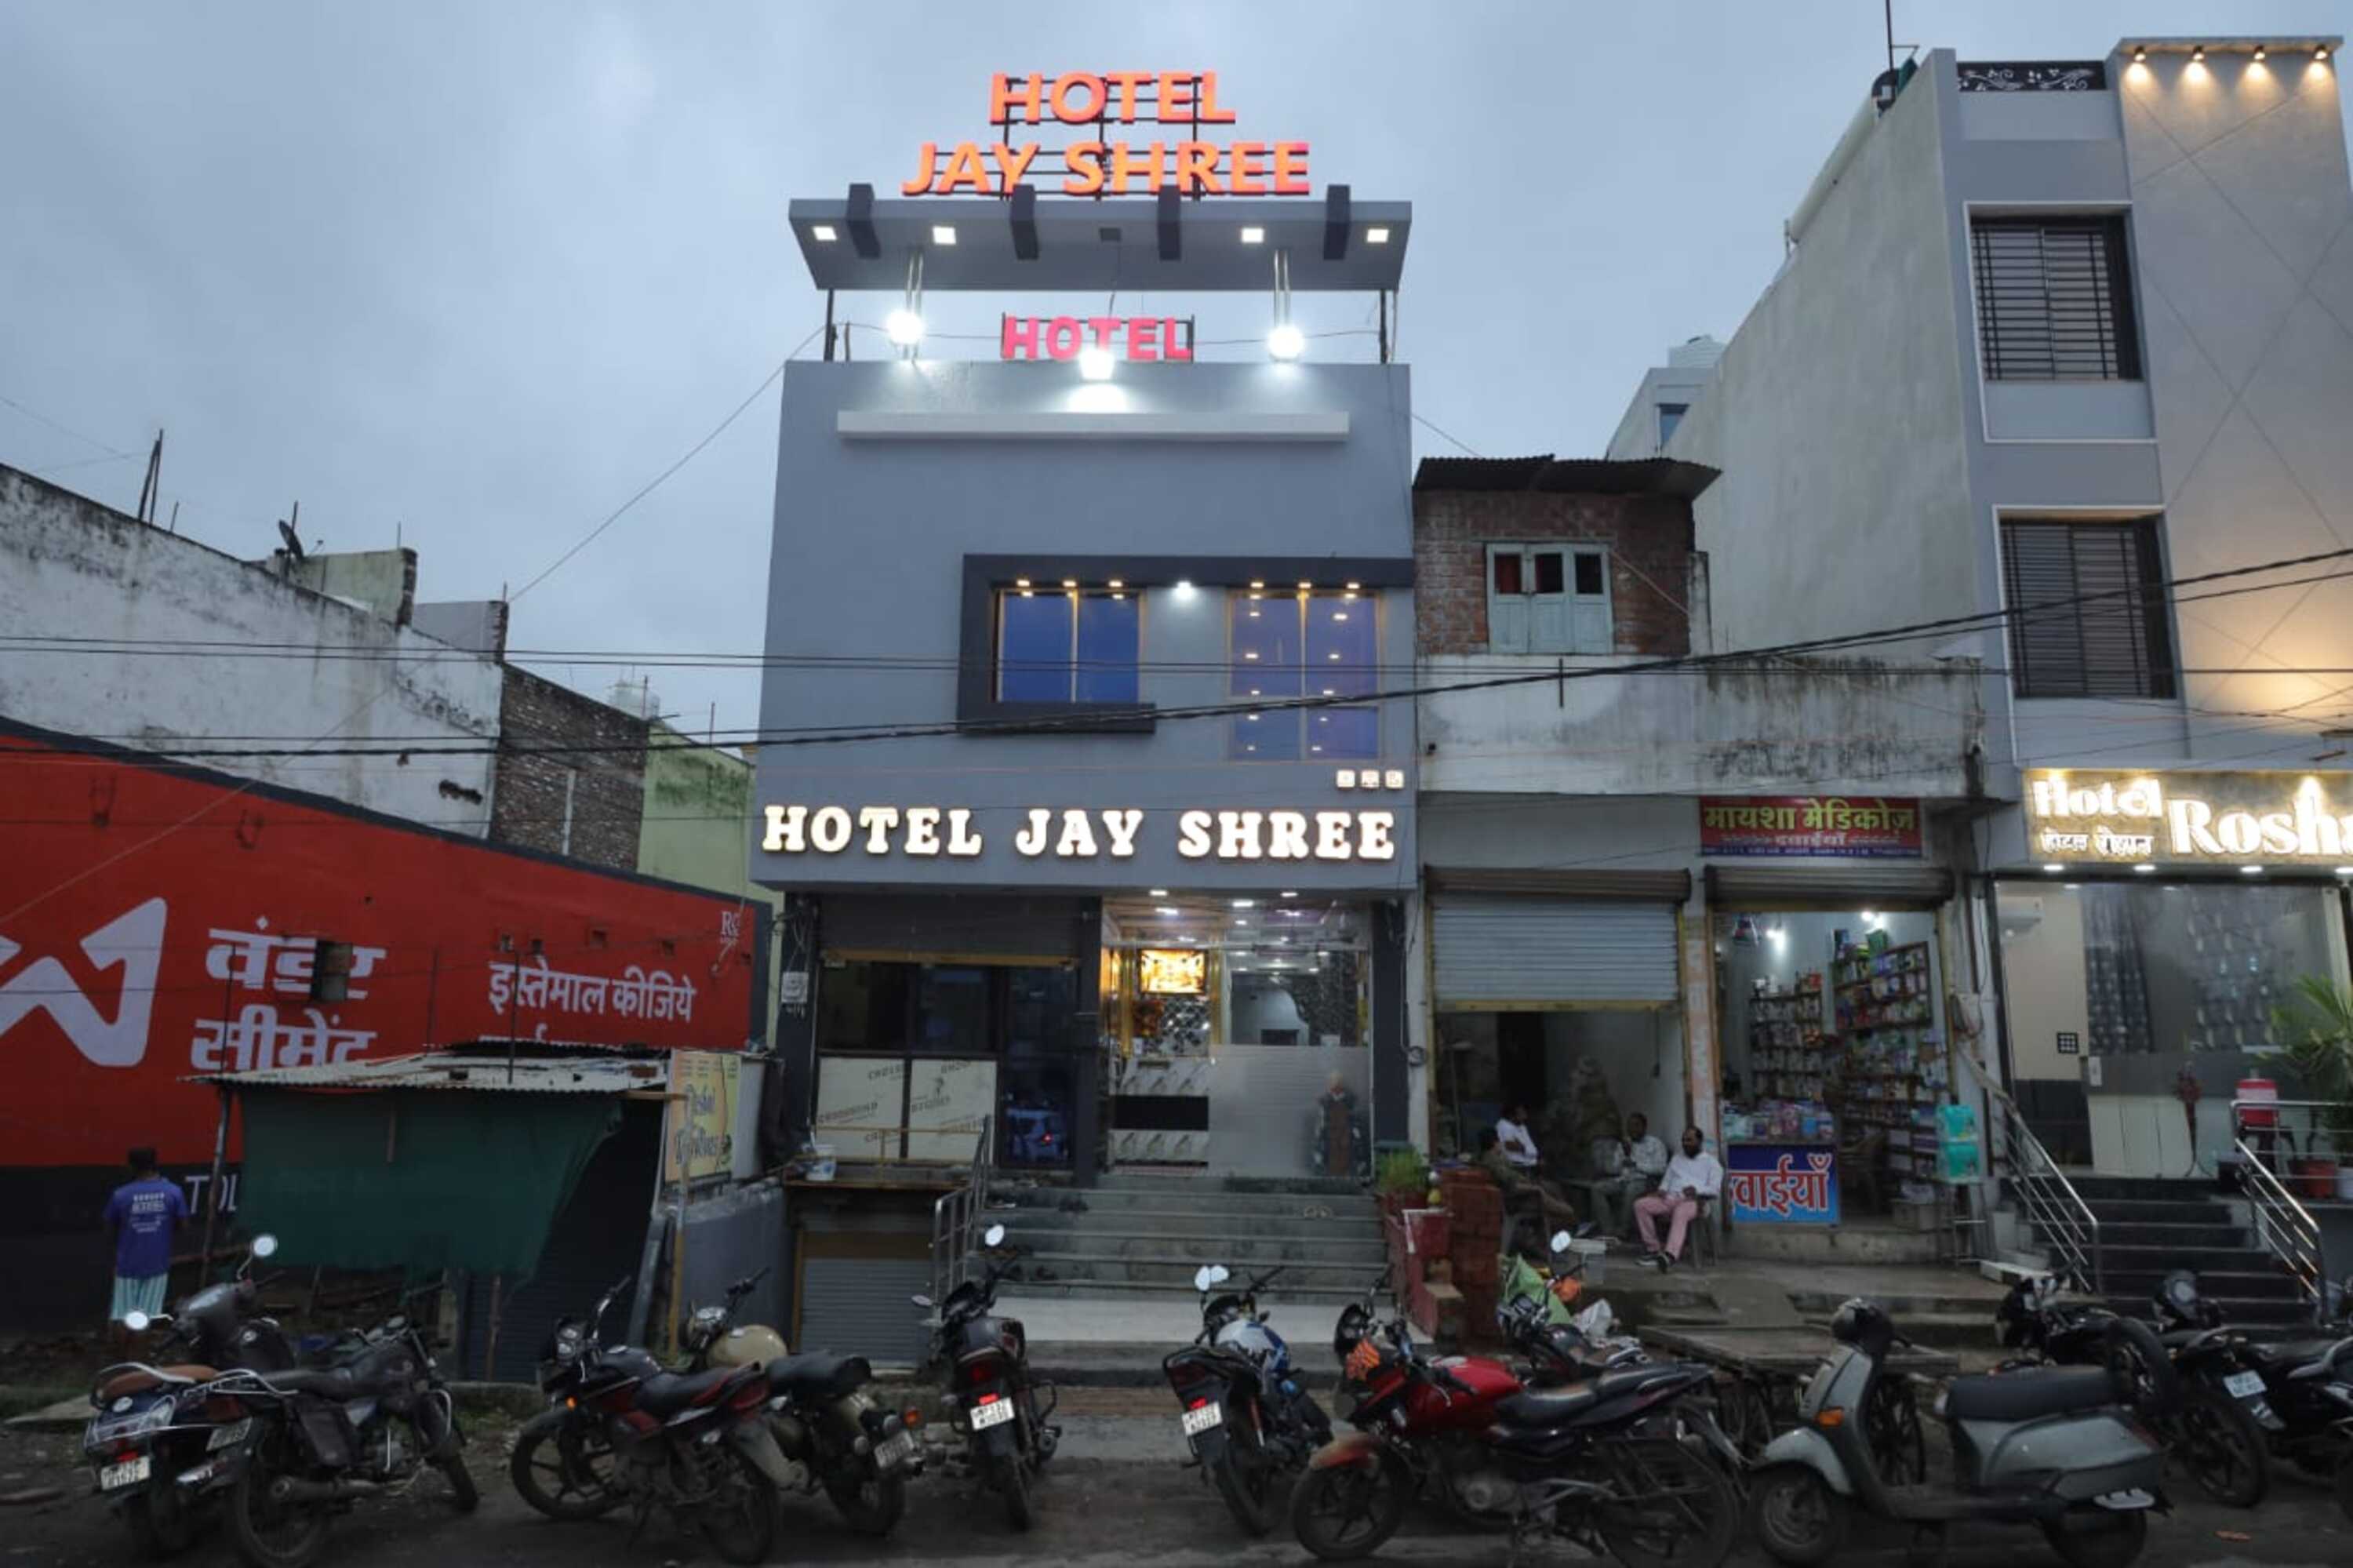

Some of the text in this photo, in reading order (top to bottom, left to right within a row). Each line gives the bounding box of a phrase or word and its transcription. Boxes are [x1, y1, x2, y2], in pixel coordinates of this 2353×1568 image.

[990, 71, 1236, 125] HOTEL
[901, 141, 1311, 196] JAY SHREE
[1001, 315, 1193, 360] HOTEL
[2032, 778, 2163, 817] Hotel
[762, 805, 1396, 860] HOTEL JAY SHREE
[489, 955, 697, 1023] इस्तेमाल कीजिये
[1728, 1153, 1832, 1217] वाईयाँ
